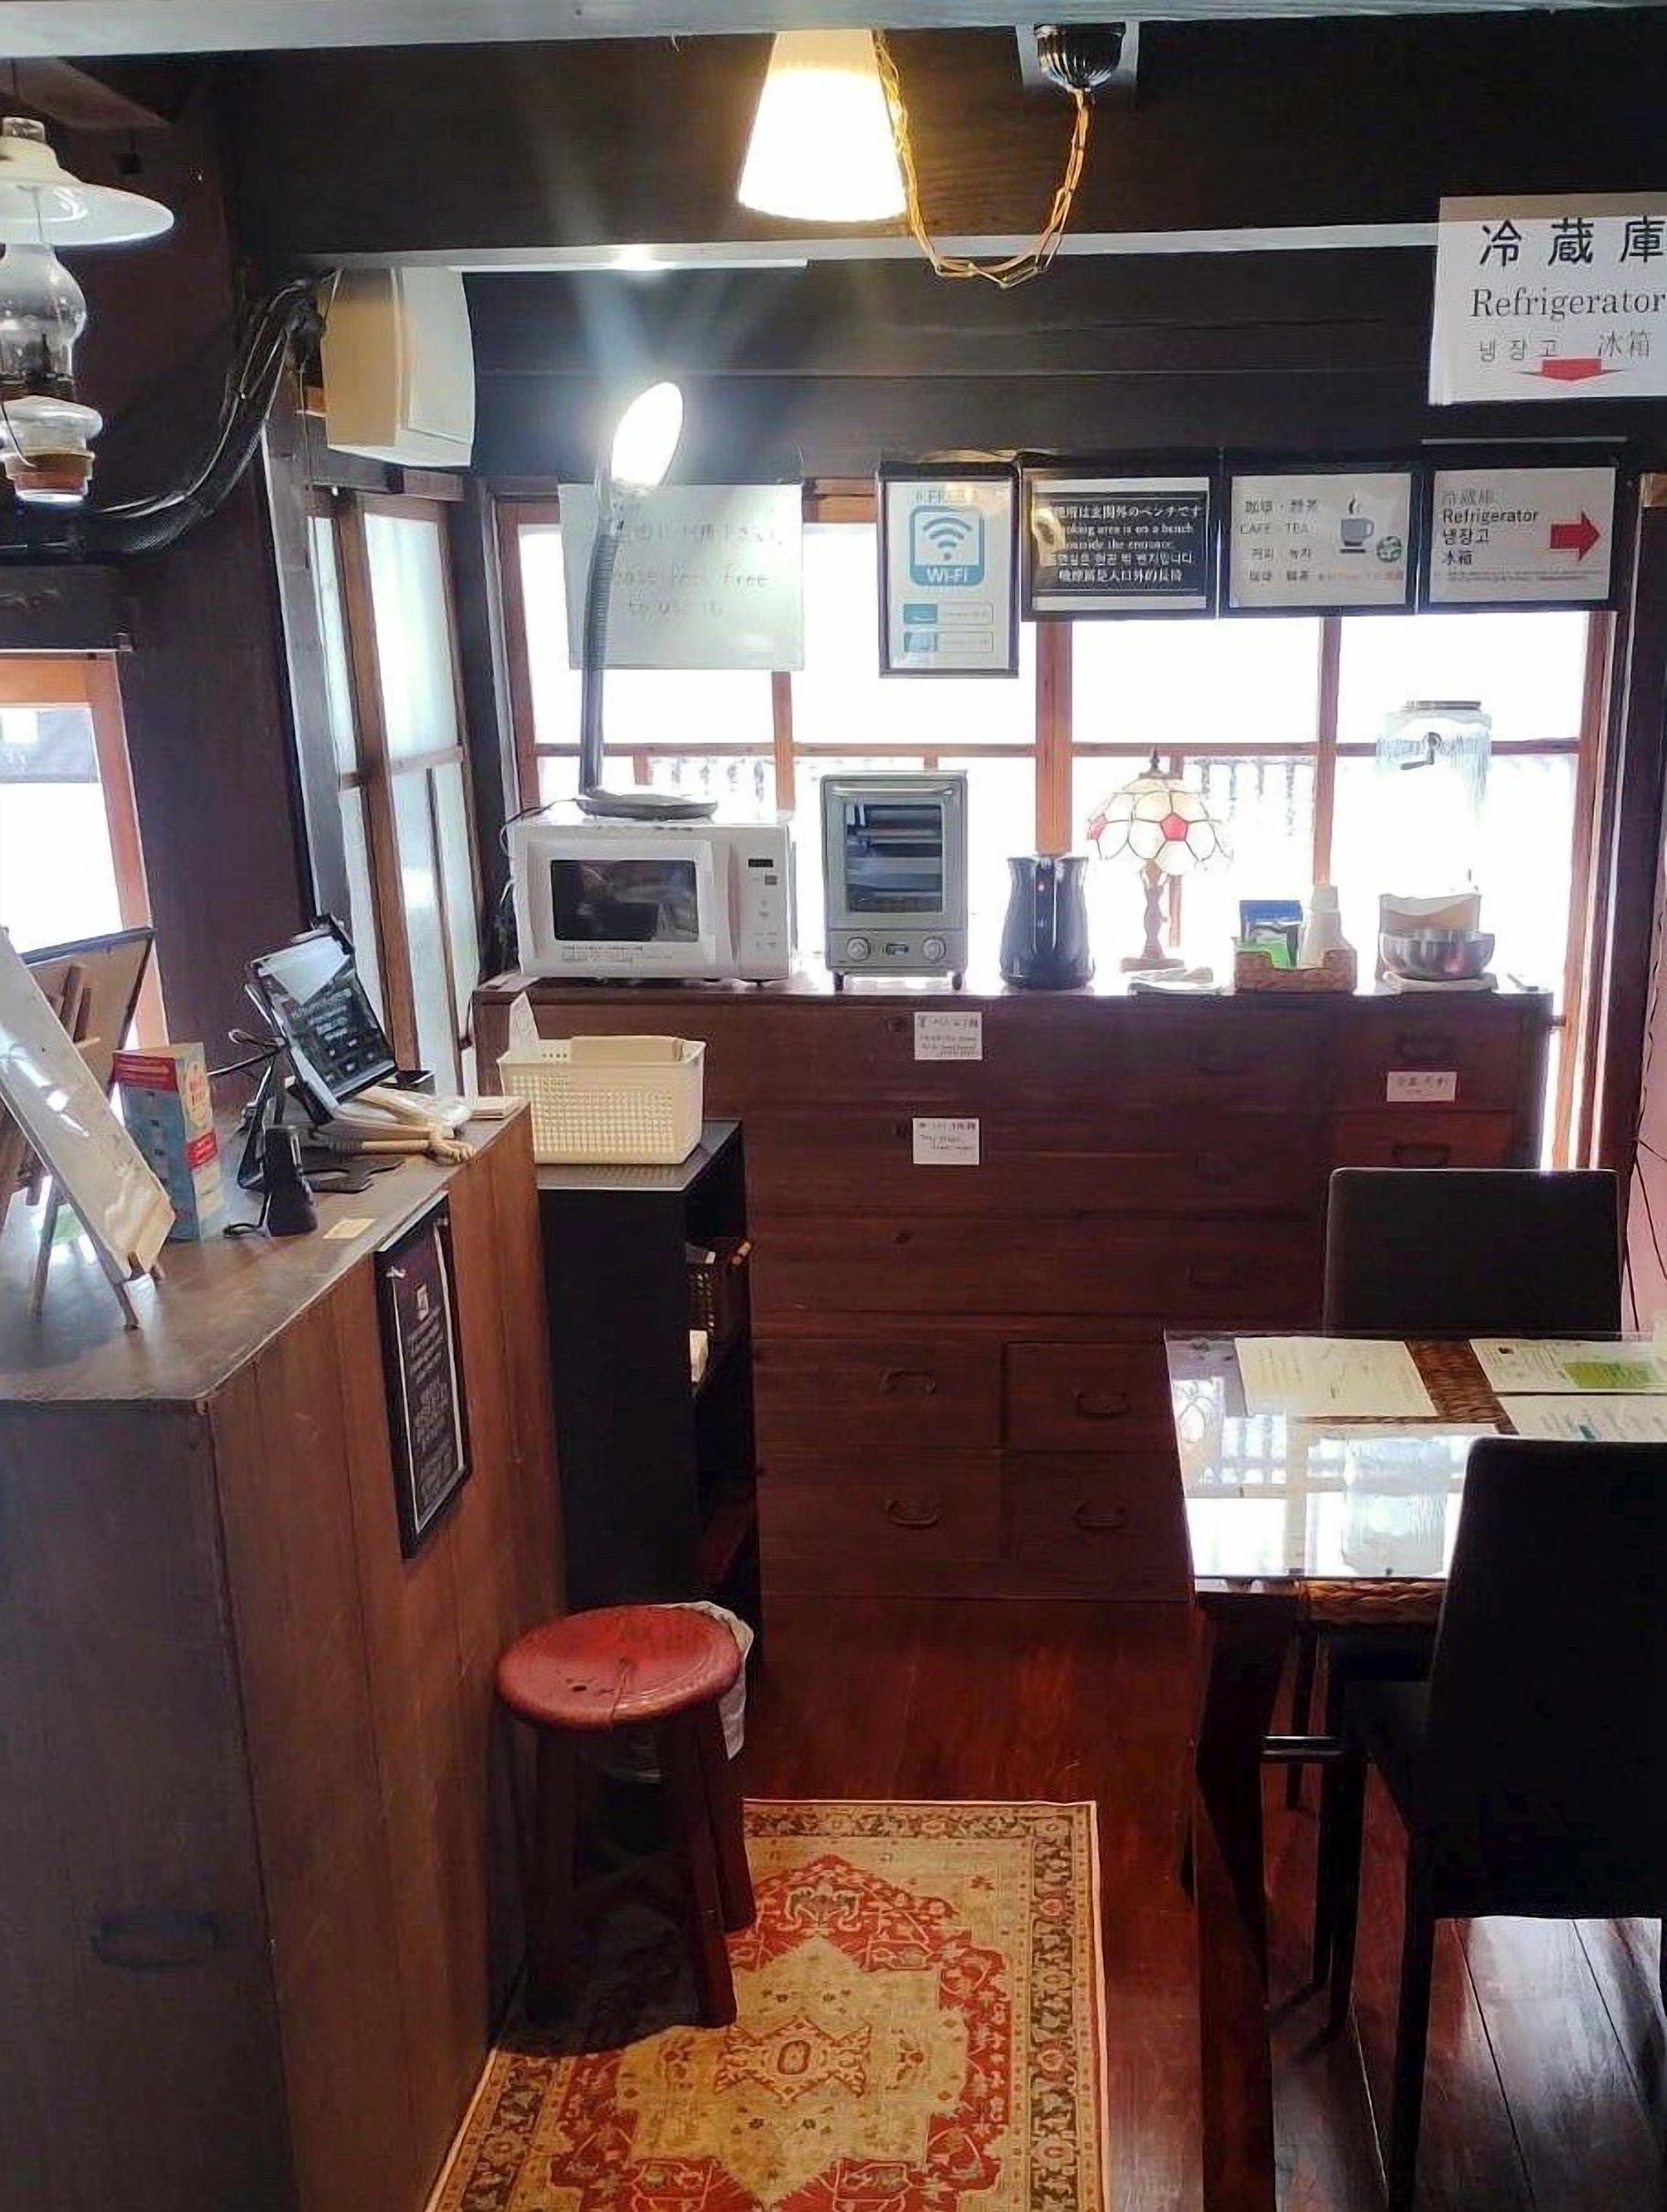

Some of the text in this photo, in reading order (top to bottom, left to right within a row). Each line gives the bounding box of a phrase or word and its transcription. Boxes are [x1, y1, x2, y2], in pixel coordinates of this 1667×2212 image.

[1479, 215, 1666, 267] 冷蔵庫
[1470, 287, 1666, 321] Refrigerator
[1479, 338, 1559, 363] 냉장고
[1443, 508, 1539, 525] Refrigerator
[1444, 529, 1490, 545] 냉장고
